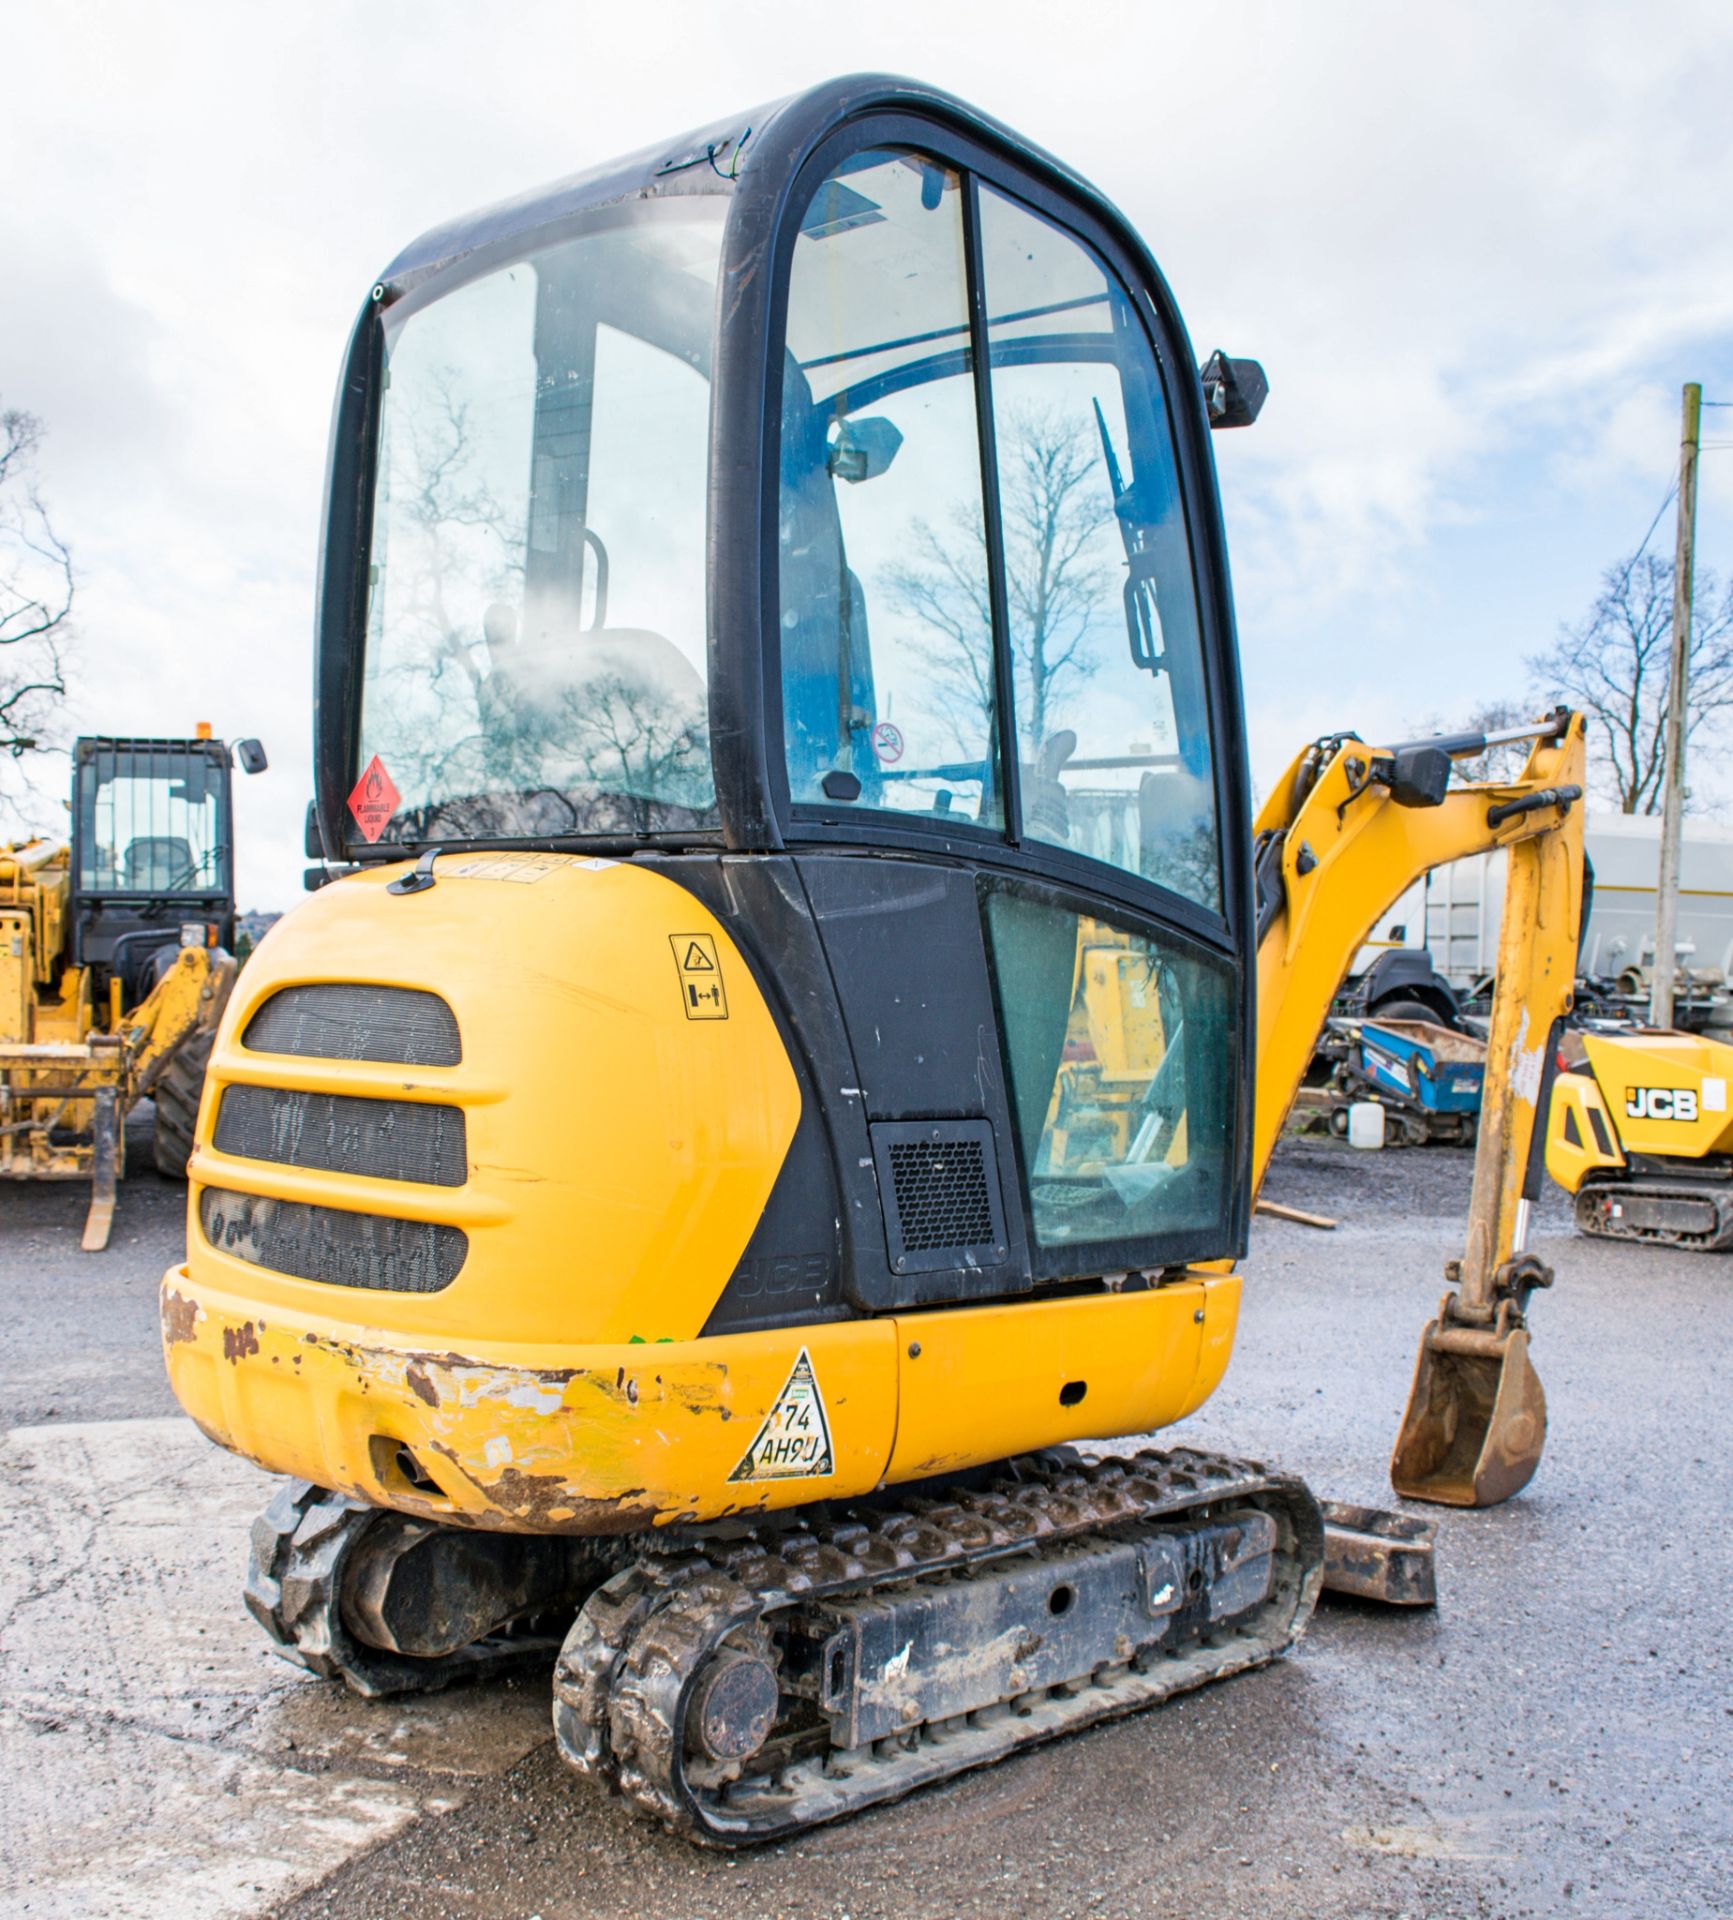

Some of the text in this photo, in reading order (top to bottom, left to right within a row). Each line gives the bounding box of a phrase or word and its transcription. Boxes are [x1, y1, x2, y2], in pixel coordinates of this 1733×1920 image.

[365, 815, 381, 823] LIQUID
[1627, 1088, 1697, 1120] JCB
[736, 1253, 829, 1297] JCB
[785, 1404, 810, 1431] 74
